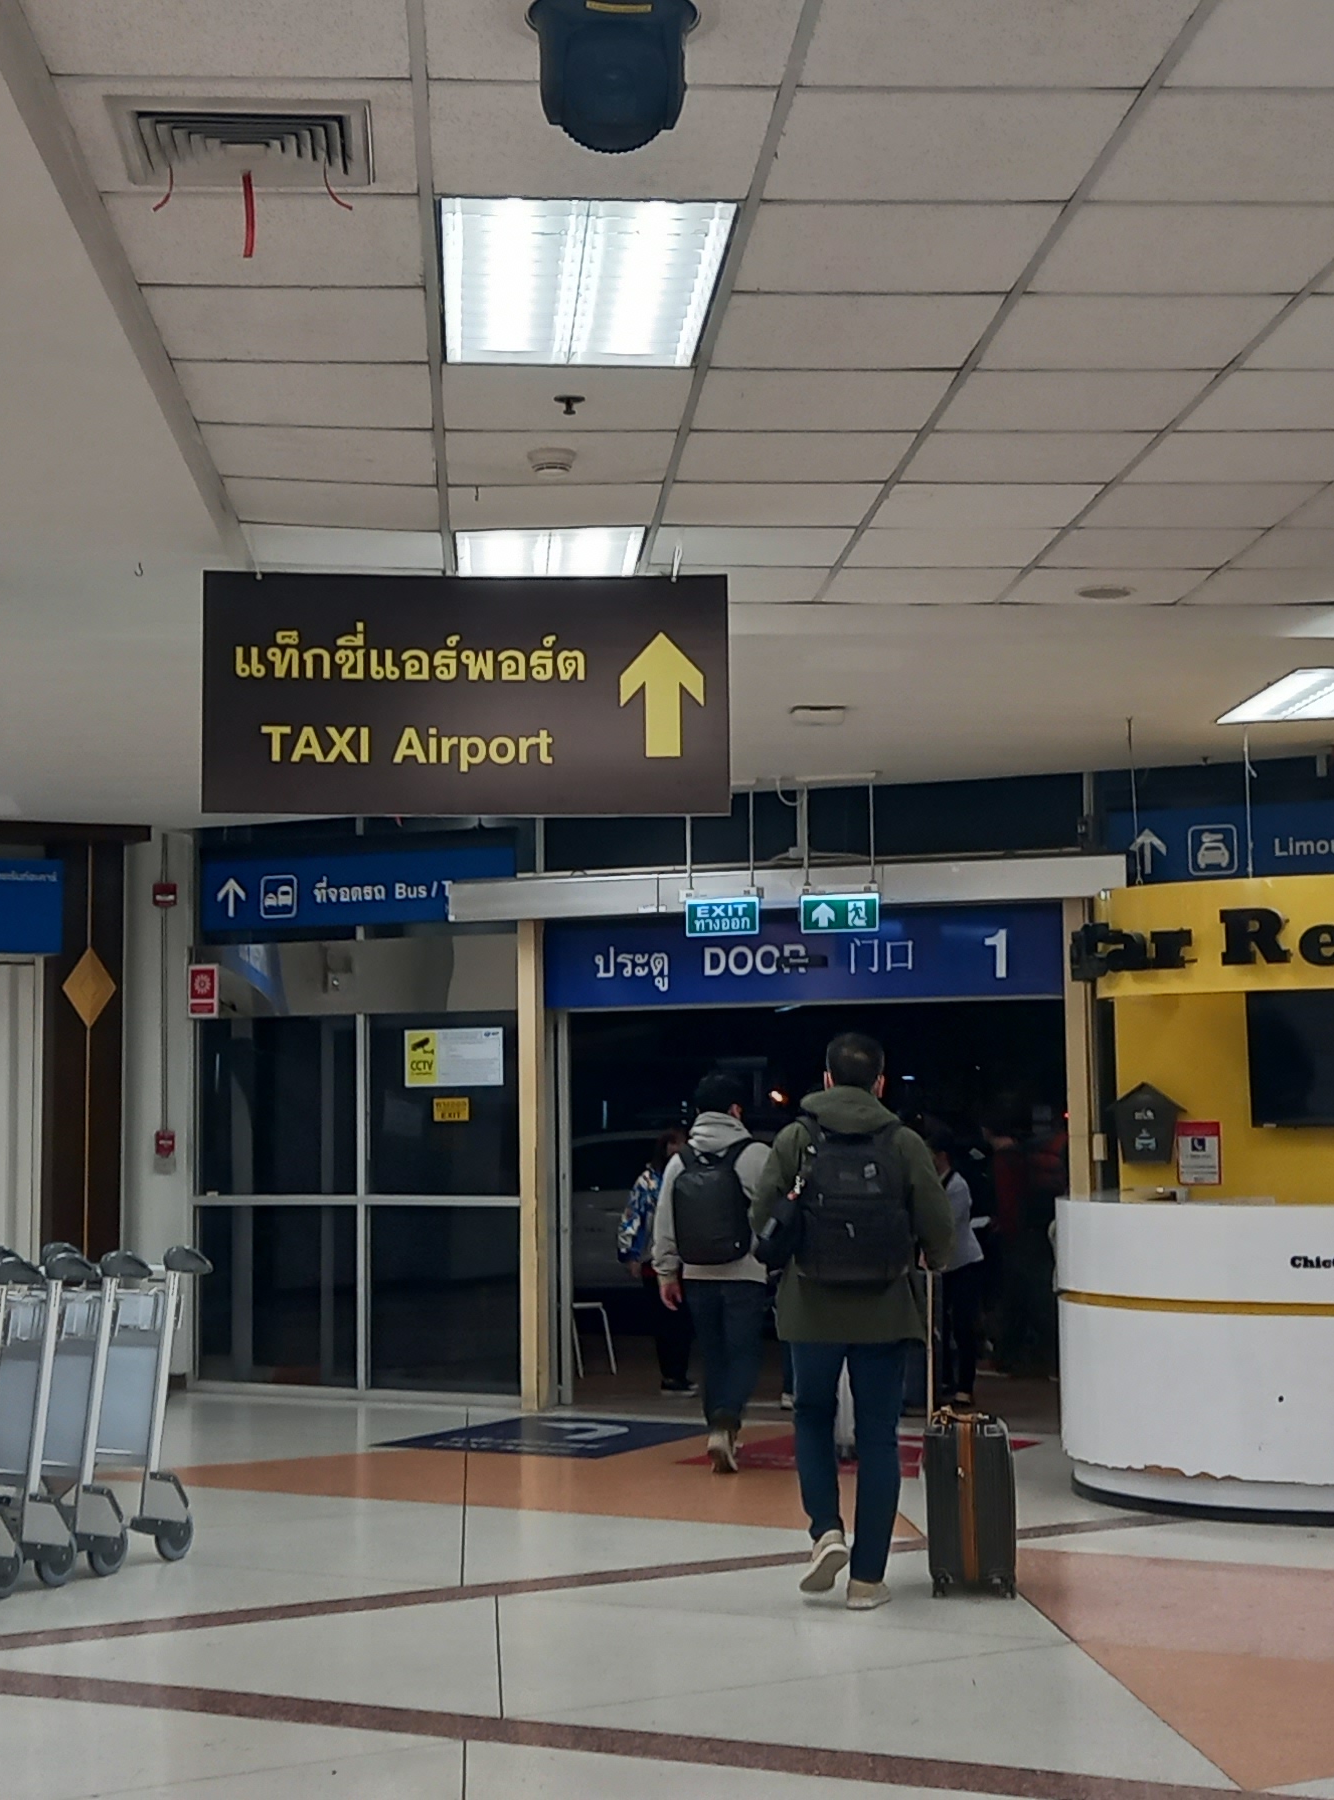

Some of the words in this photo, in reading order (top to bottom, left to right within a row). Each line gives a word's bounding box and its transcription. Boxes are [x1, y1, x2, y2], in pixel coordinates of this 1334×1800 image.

[234, 622, 587, 681] แท็กซี่แอร์พอร์ต
[261, 725, 370, 763] TAXI
[392, 726, 553, 772] Airport
[312, 875, 386, 903] ที่จอดรถ
[694, 916, 751, 932] ทางออก
[696, 904, 748, 918] EXIT
[594, 946, 670, 992] ประตู
[703, 943, 807, 977] DOOR
[849, 937, 914, 975] 门口
[983, 928, 1009, 979] 1
[410, 1060, 434, 1071] CCTV
